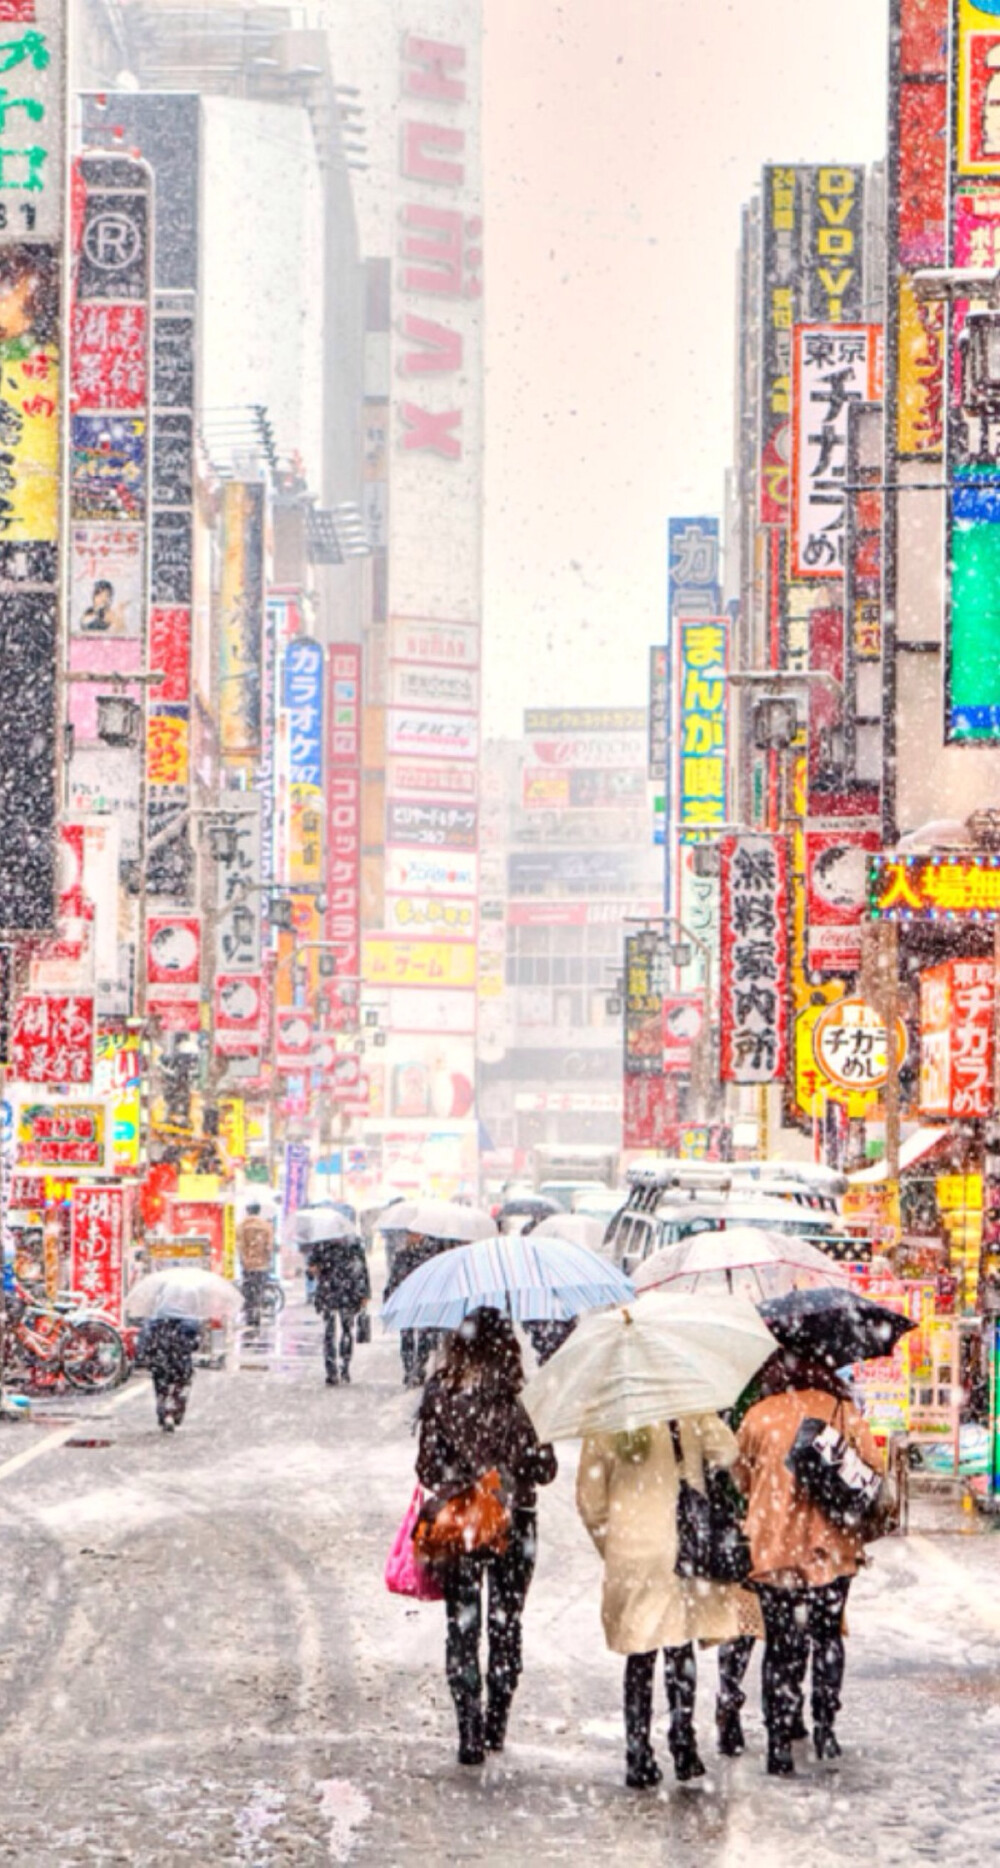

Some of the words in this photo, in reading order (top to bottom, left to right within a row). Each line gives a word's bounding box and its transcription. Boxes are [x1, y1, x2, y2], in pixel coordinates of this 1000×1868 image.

[804, 333, 866, 368] 東京
[807, 367, 863, 531] チカラ
[288, 648, 318, 763] カラオケ
[733, 847, 777, 1072] 無料案内所
[953, 1089, 992, 1113] めし
